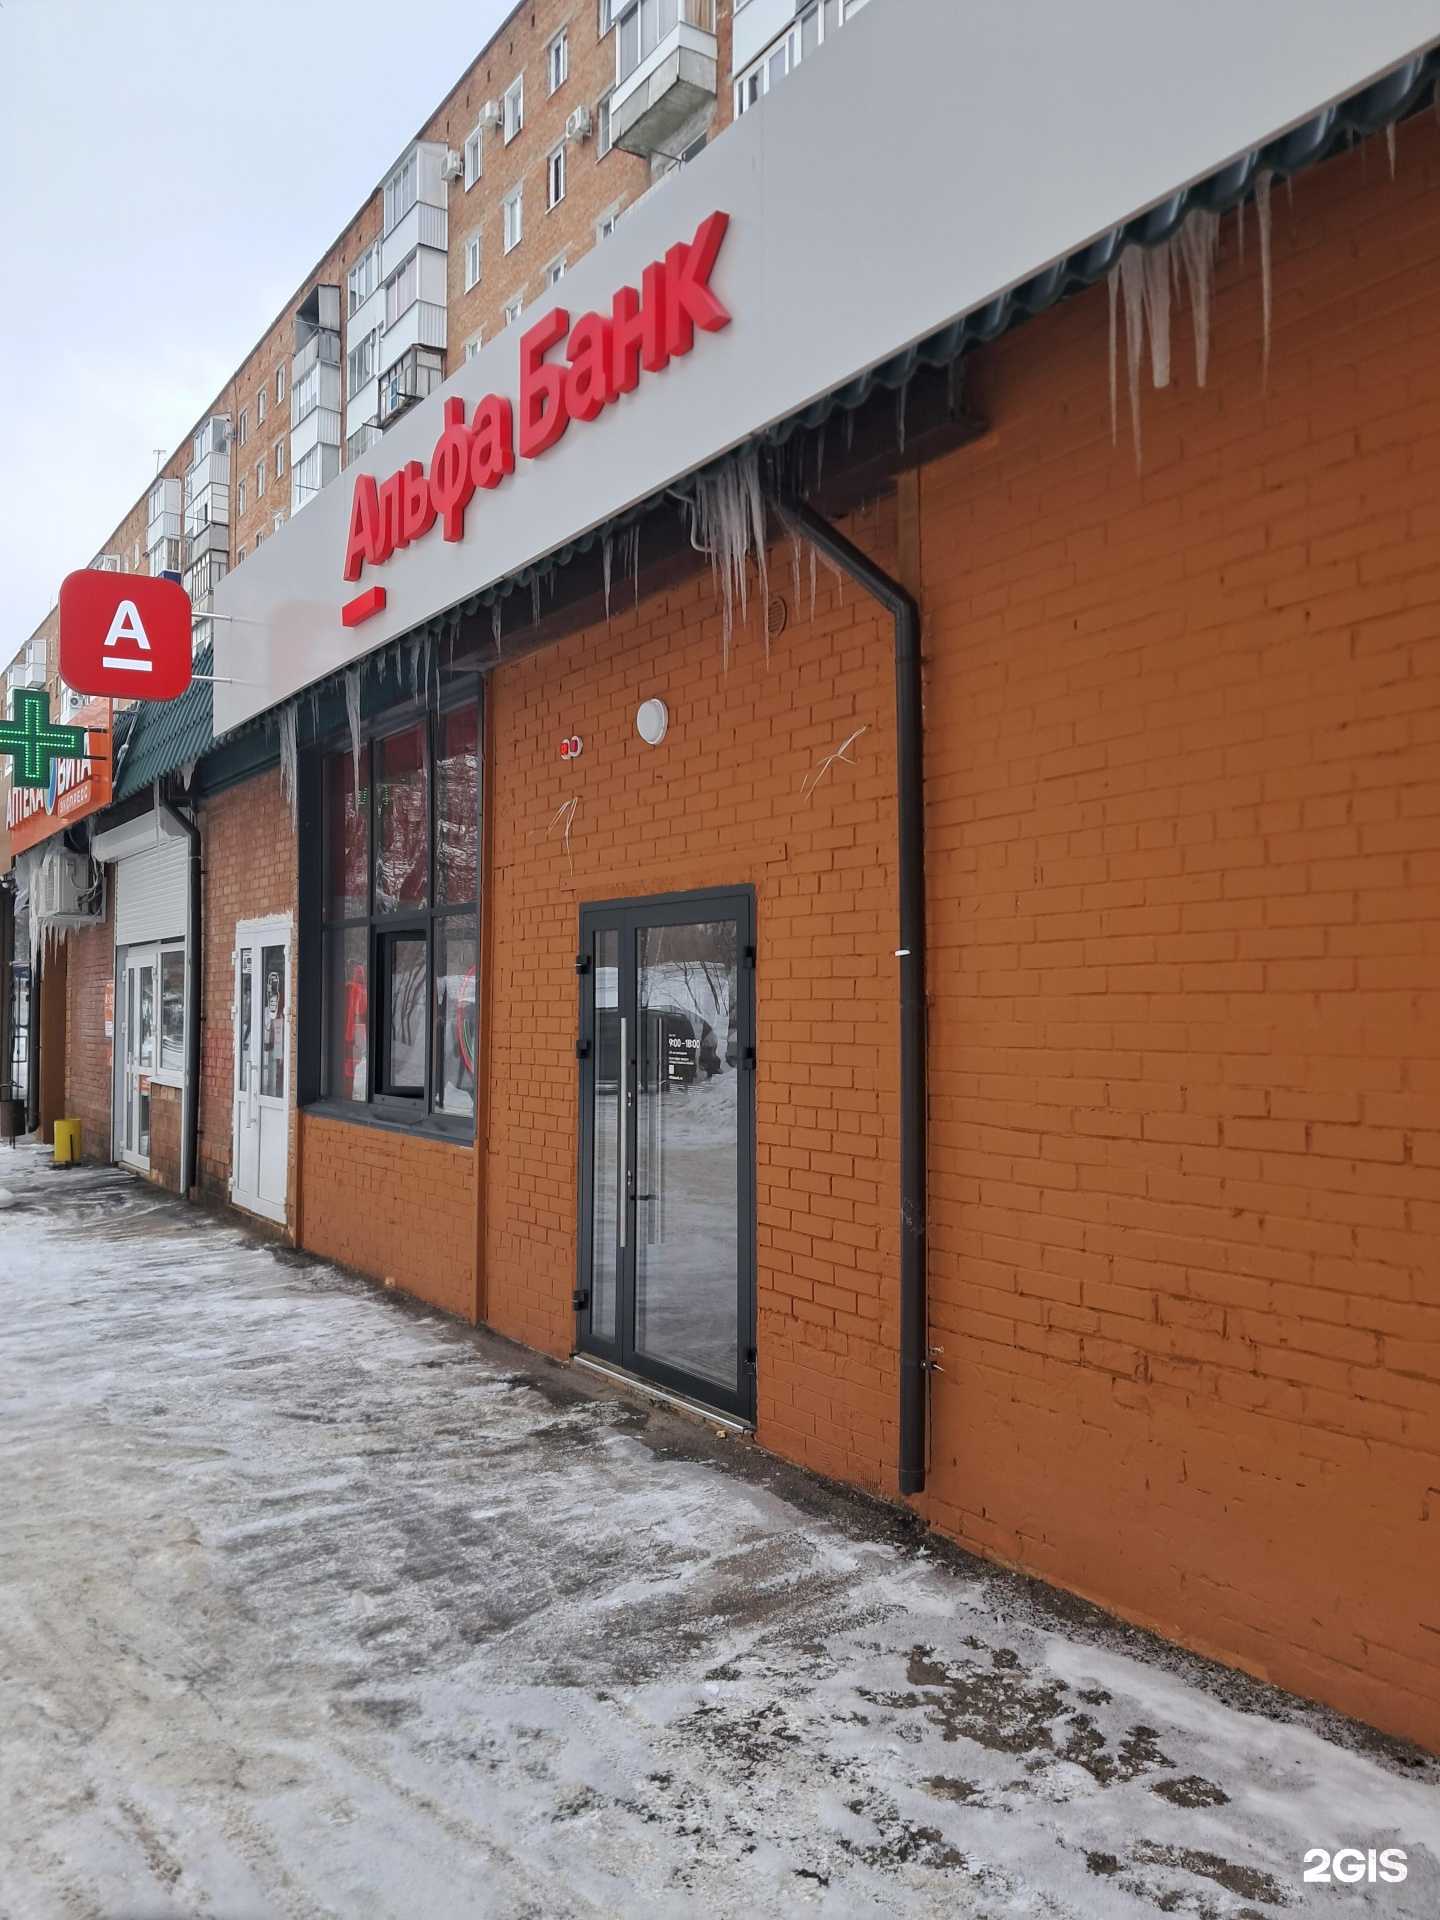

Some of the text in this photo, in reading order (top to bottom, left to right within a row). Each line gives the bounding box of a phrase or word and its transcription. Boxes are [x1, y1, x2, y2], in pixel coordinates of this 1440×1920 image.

[343, 210, 732, 581] Альфа Банк
[103, 599, 151, 650] А
